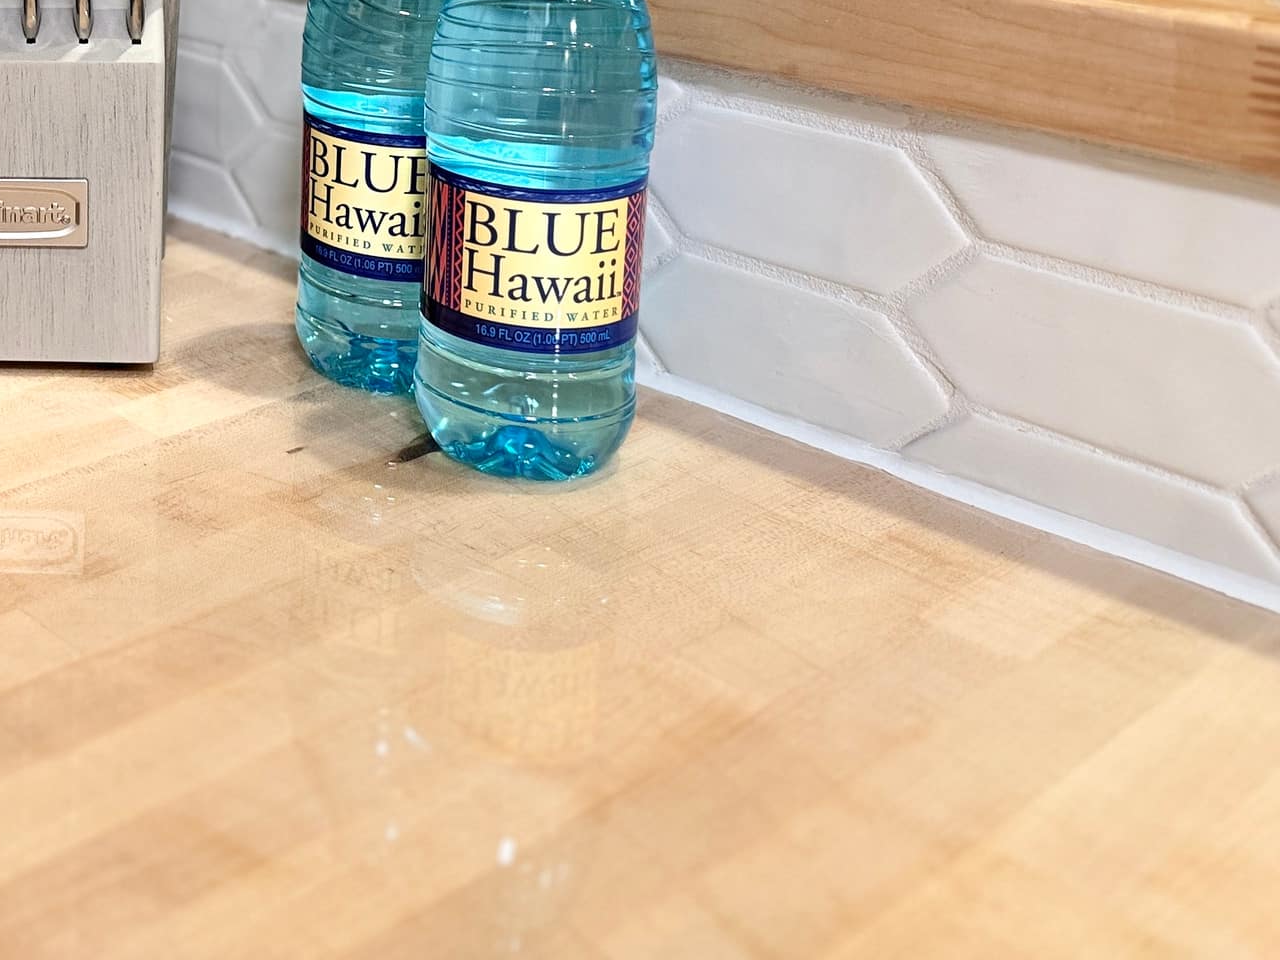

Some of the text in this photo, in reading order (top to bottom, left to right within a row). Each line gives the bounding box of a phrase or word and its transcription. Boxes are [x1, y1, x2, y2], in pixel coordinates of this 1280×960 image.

[309, 176, 425, 238] Hawai
[310, 222, 424, 254] PURIFIED WAT
[464, 199, 621, 257] BLUE
[329, 250, 339, 262] FL
[340, 254, 353, 266] OZ
[395, 263, 413, 274] 500
[463, 246, 618, 304] Hawaii
[464, 299, 619, 323] PURIFIED WATER
[475, 323, 497, 338] 16.9
[498, 328, 513, 341] FL
[514, 330, 532, 344] OZ
[560, 333, 578, 347] PT)
[580, 331, 597, 344] 500
[598, 328, 611, 341] mL
